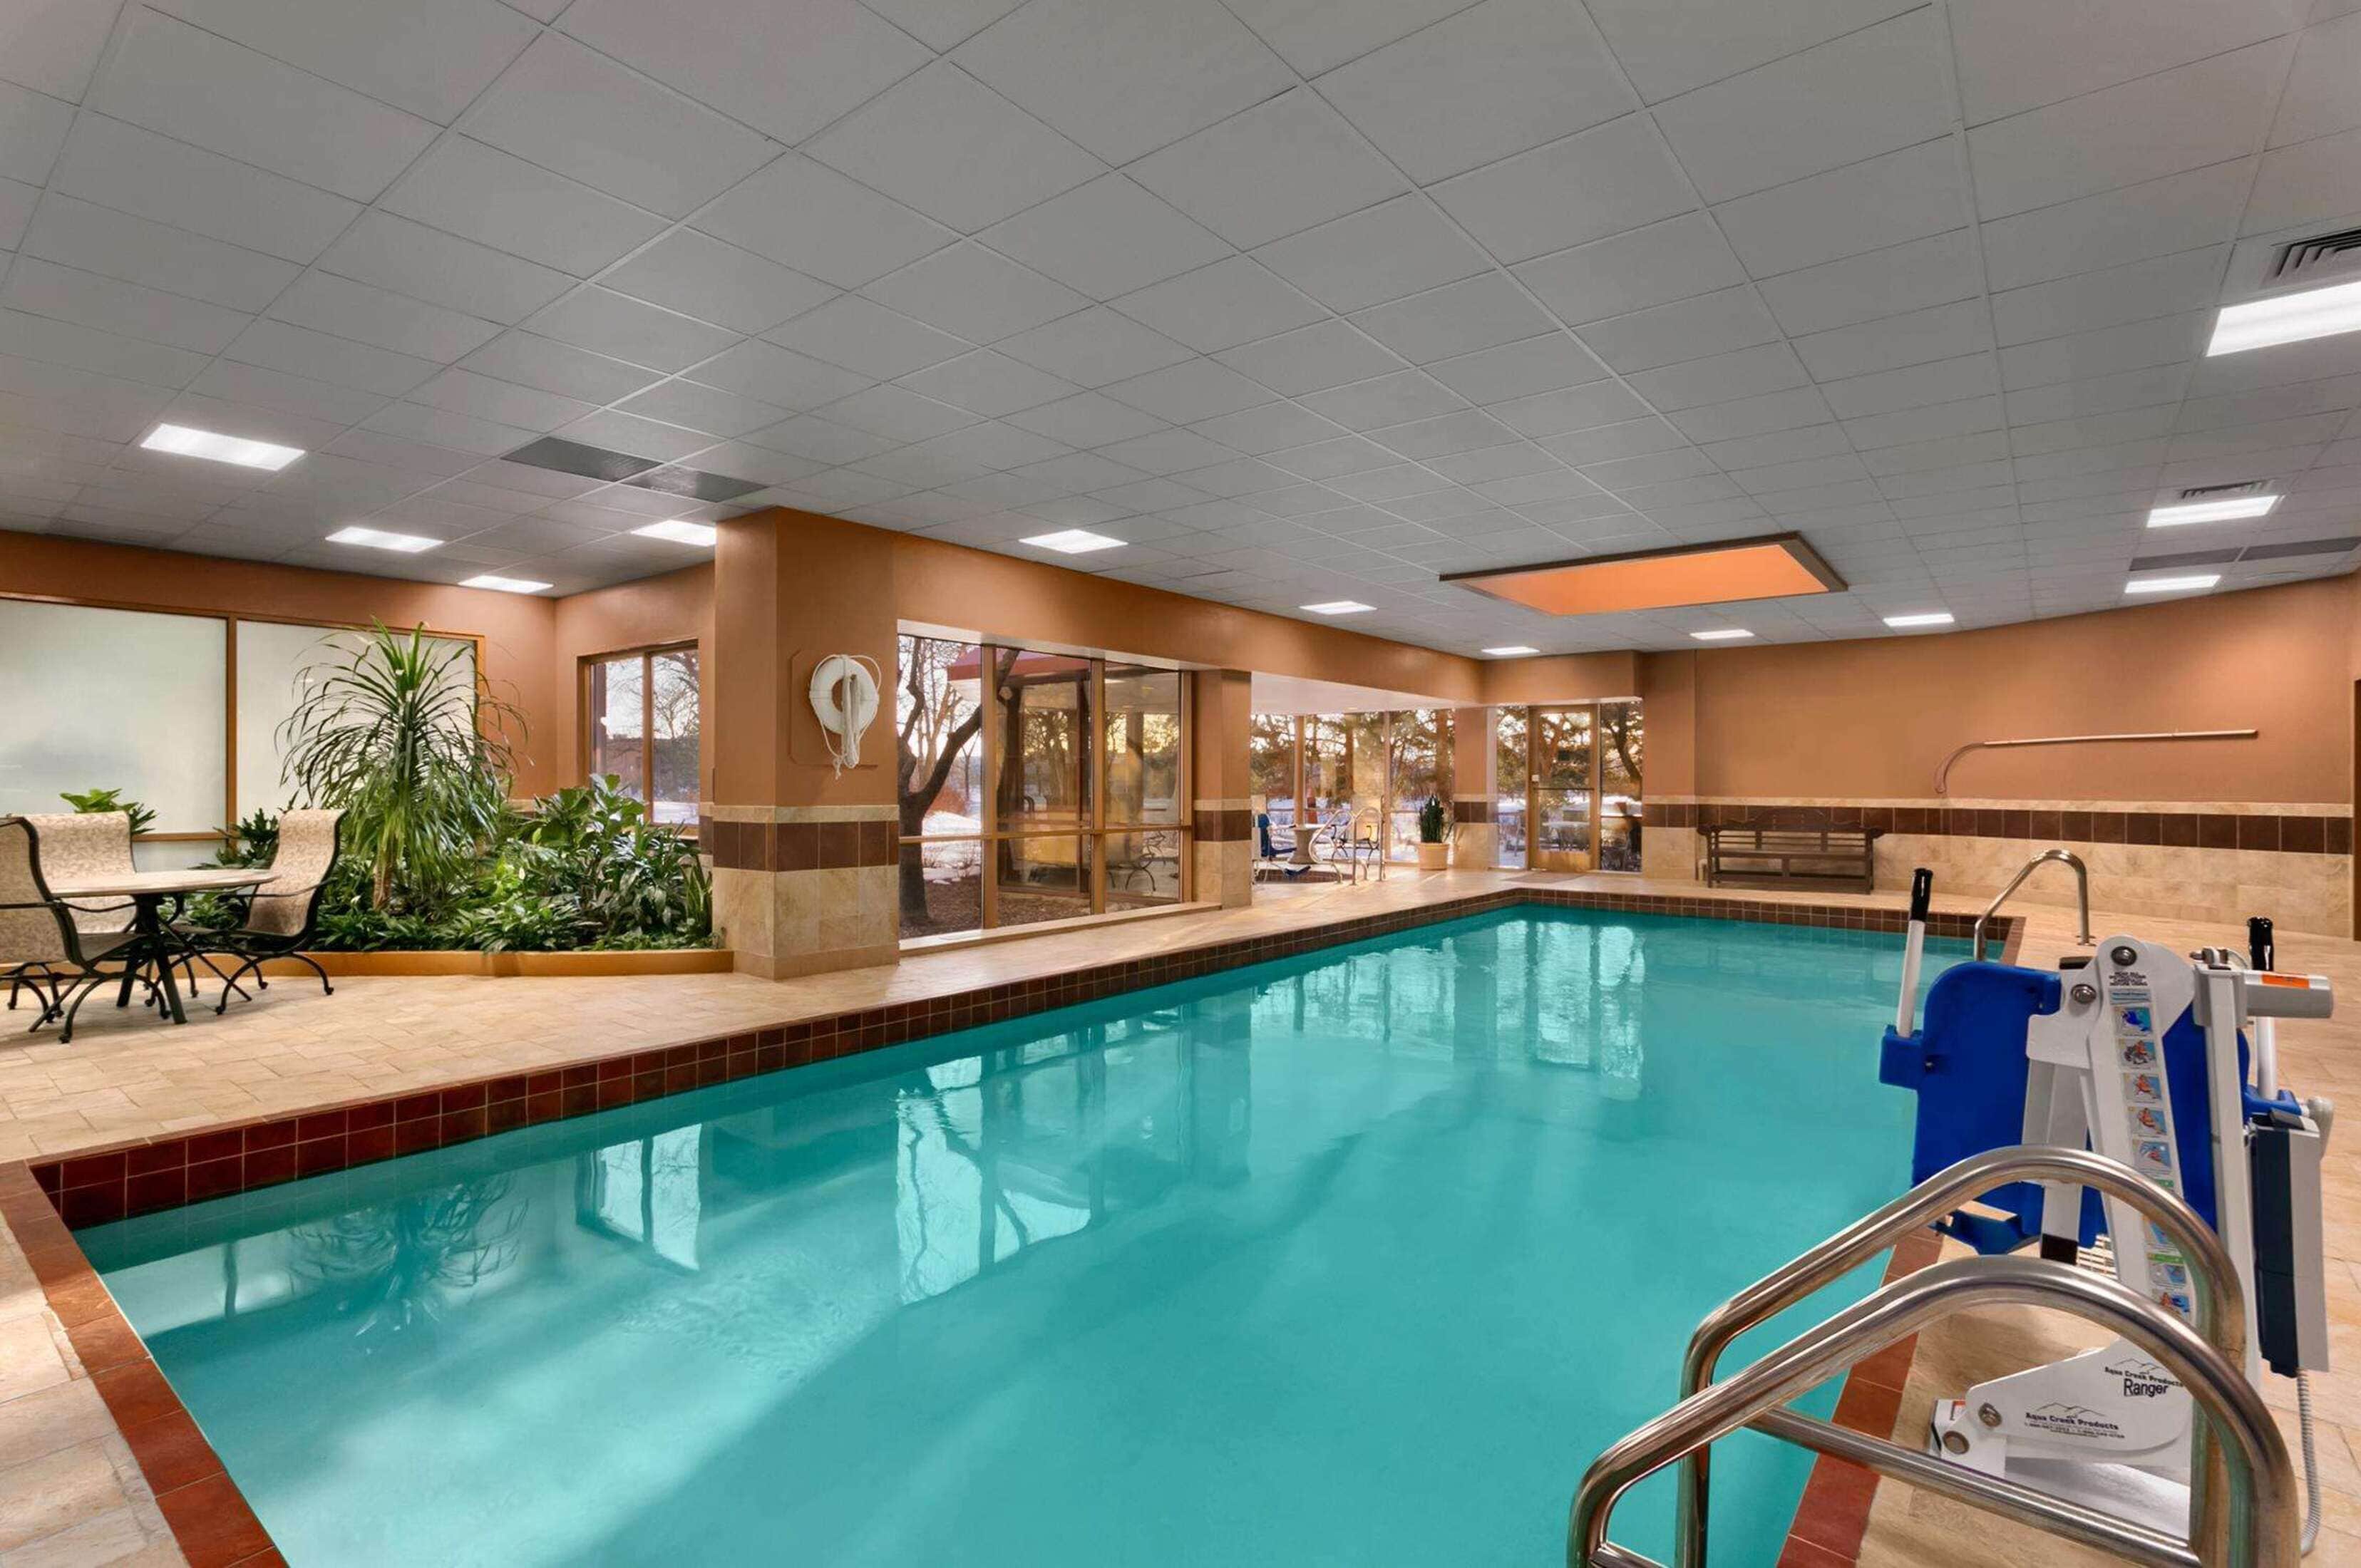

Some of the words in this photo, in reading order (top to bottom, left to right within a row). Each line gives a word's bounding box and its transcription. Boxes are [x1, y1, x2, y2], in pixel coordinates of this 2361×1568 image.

[2104, 1366, 2123, 1376] Aqua
[2124, 1370, 2148, 1381] Creek
[2124, 1378, 2169, 1398] Ranger
[2025, 1412, 2047, 1422] Aqua
[2049, 1415, 2076, 1425] Creek
[2077, 1418, 2119, 1430] Products
